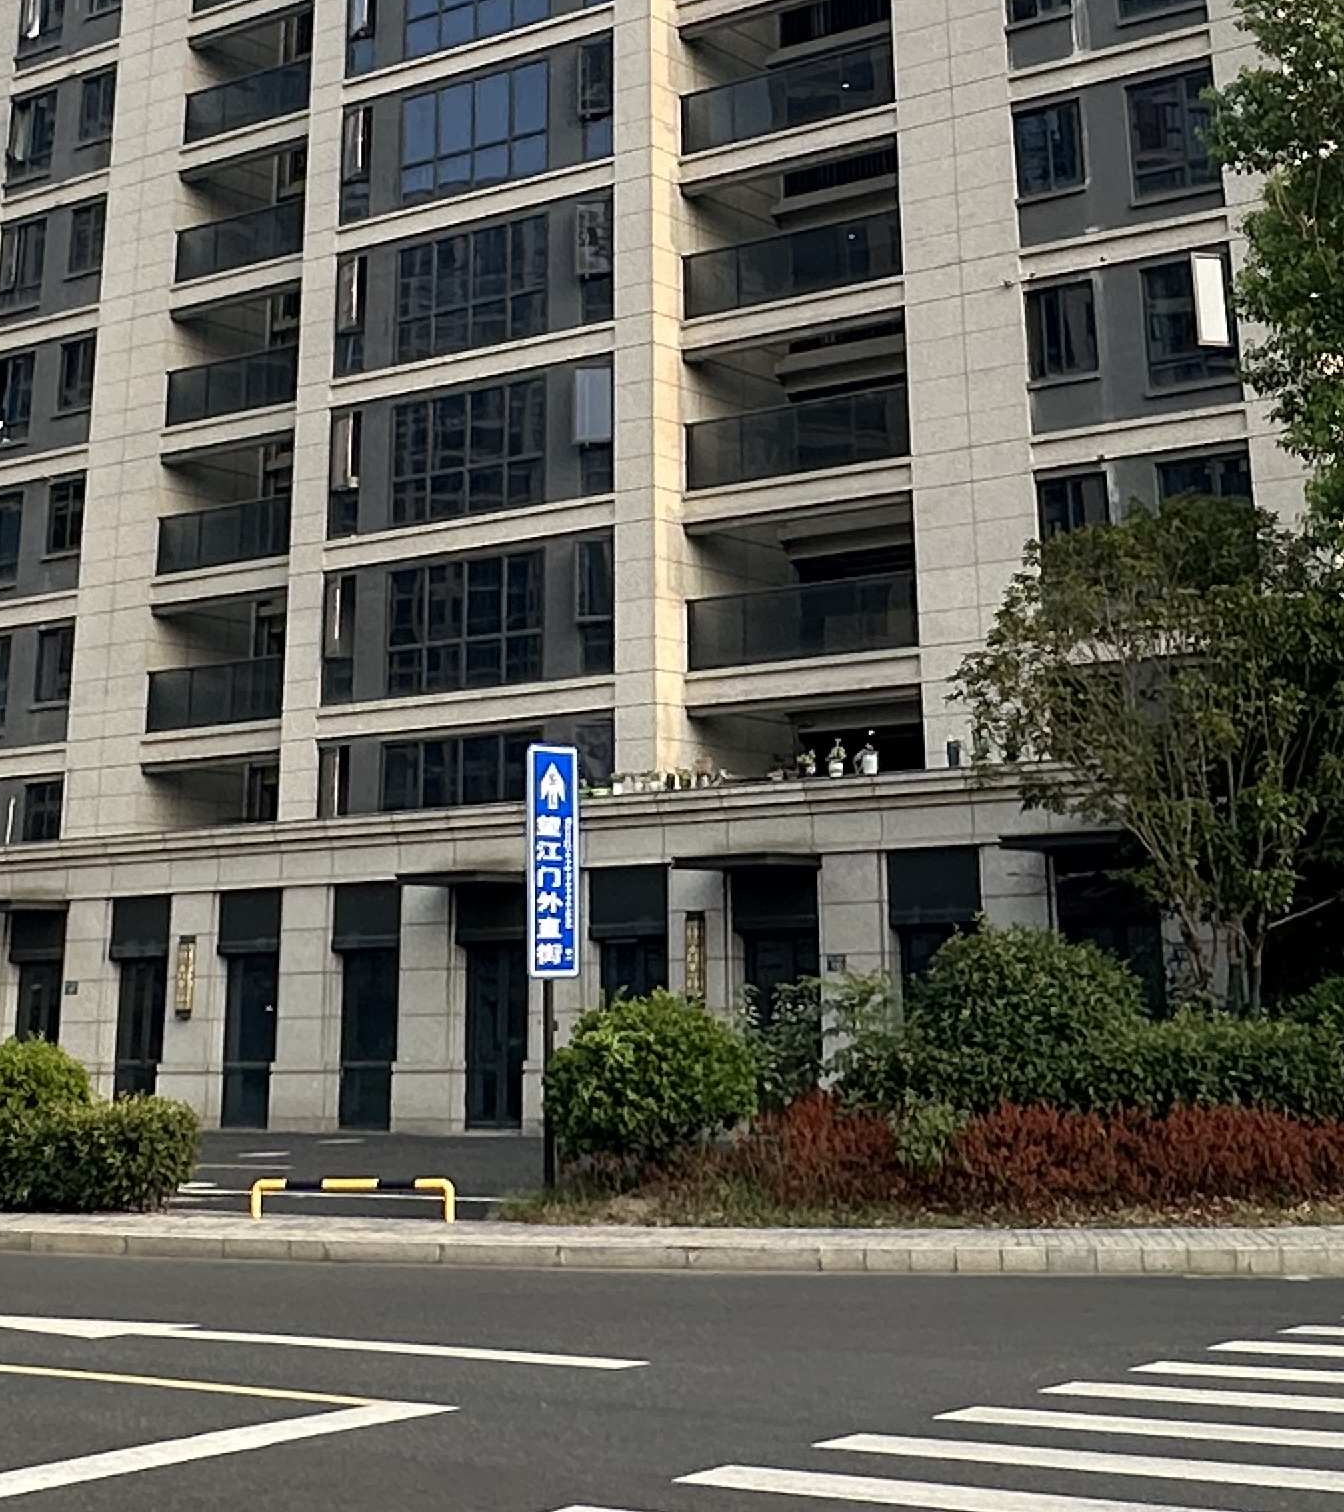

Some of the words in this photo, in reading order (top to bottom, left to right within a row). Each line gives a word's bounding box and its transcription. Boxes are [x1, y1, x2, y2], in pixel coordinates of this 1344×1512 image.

[536, 814, 563, 965] 望江门外直街
